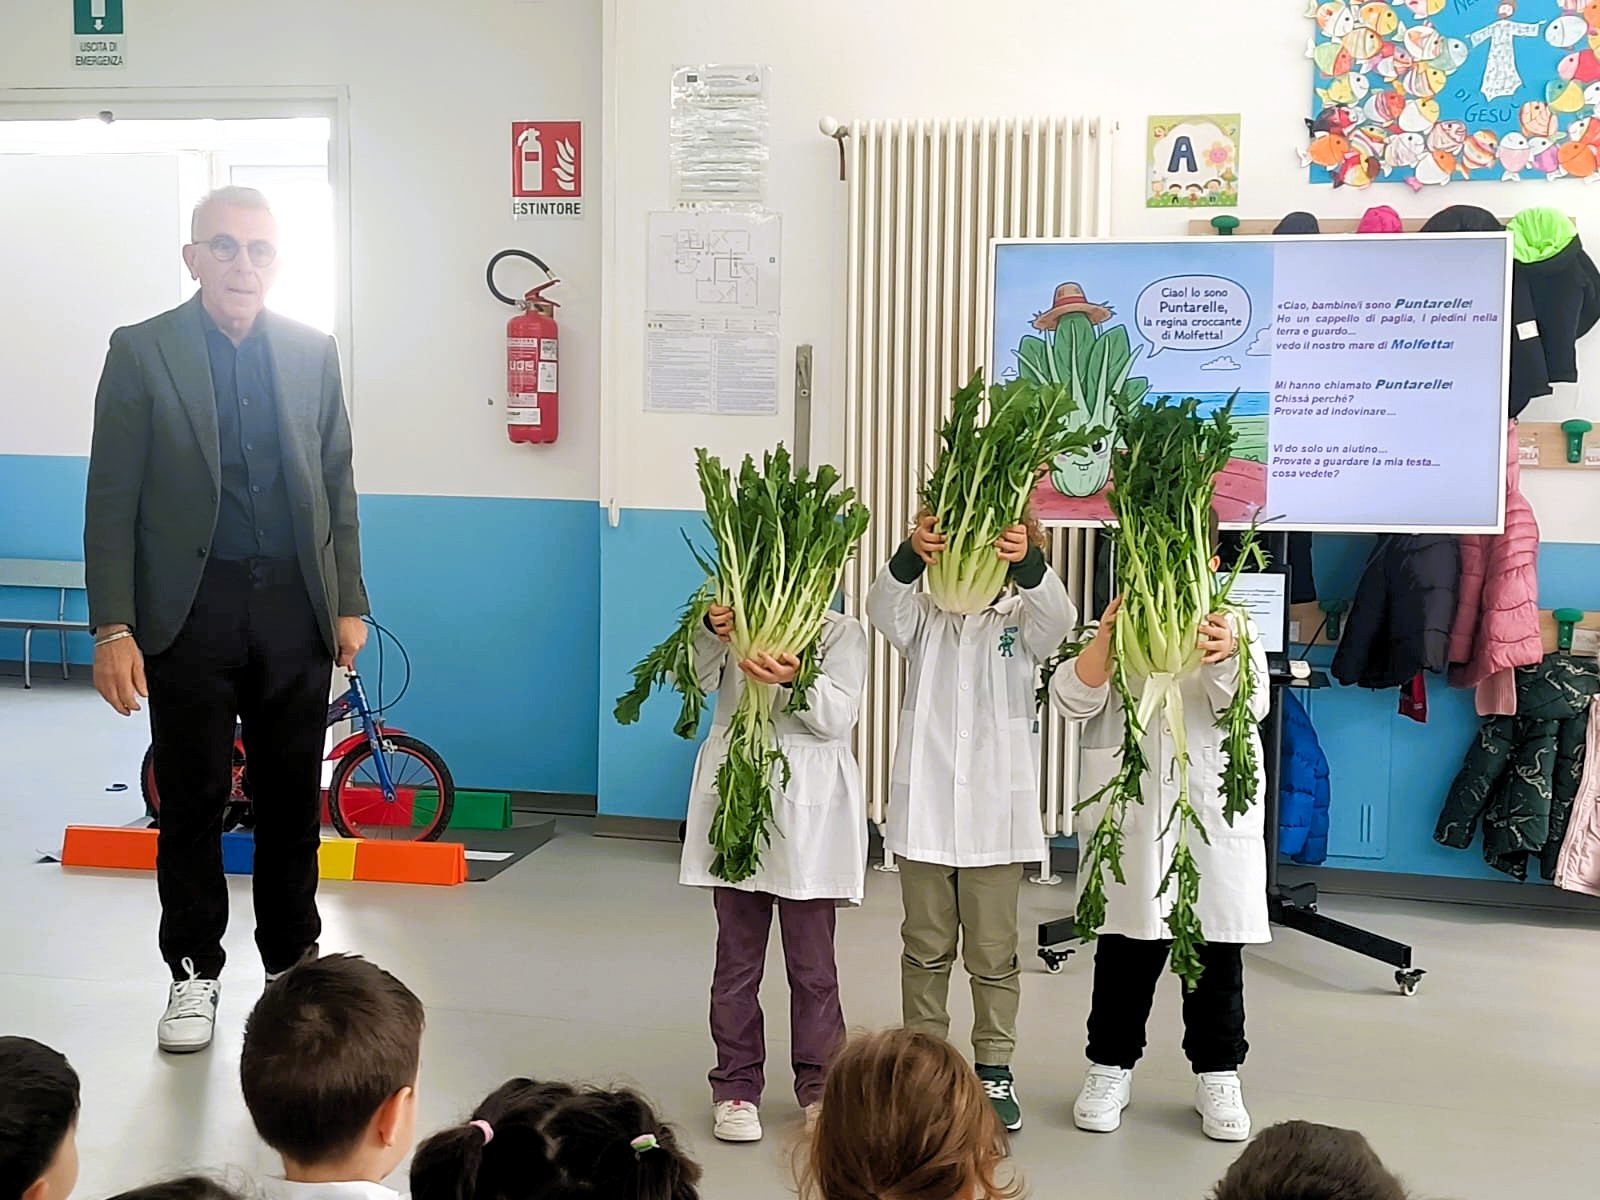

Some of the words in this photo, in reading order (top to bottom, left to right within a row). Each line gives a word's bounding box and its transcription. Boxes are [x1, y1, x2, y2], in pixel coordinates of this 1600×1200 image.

[79, 41, 107, 52] USCITA
[109, 41, 118, 52] DI
[75, 55, 123, 66] EMERGENZA
[1454, 87, 1472, 103] DI
[1167, 135, 1198, 173] A
[512, 202, 582, 215] ESTINTORE
[1203, 289, 1228, 298] sono
[1159, 301, 1228, 315] Puntarelle,
[1364, 301, 1391, 310] sono
[1143, 316, 1153, 326] la
[1155, 317, 1188, 328] regina
[1191, 317, 1242, 327] croccante
[1276, 314, 1291, 323] Ho
[1315, 314, 1360, 325] cappello
[1365, 313, 1376, 323] di
[1380, 313, 1416, 325] paglia,
[1430, 312, 1467, 325] piedini
[1472, 313, 1498, 323] nella
[1161, 331, 1171, 340] di
[1174, 330, 1224, 340] Molfetta!
[1276, 327, 1300, 336] terra
[1276, 341, 1301, 350] vedo
[1302, 341, 1311, 350] il
[1312, 342, 1346, 350] nostro
[1348, 342, 1375, 350] mare
[1377, 340, 1388, 350] di
[1274, 380, 1287, 390] Mi
[1288, 380, 1321, 390] hanno
[1323, 380, 1372, 390] chiamato
[1273, 406, 1314, 416] Provate
[1315, 406, 1330, 416] ad
[1273, 443, 1283, 453] Vi
[1284, 443, 1299, 453] do
[1301, 443, 1324, 453] solo
[1326, 445, 1339, 453] un
[1272, 456, 1312, 466] Provate
[1322, 456, 1370, 468] guardare
[1371, 456, 1382, 466] la
[1384, 457, 1404, 466] mia
[1271, 470, 1297, 478] cosa
[1298, 469, 1340, 478] vedete?
